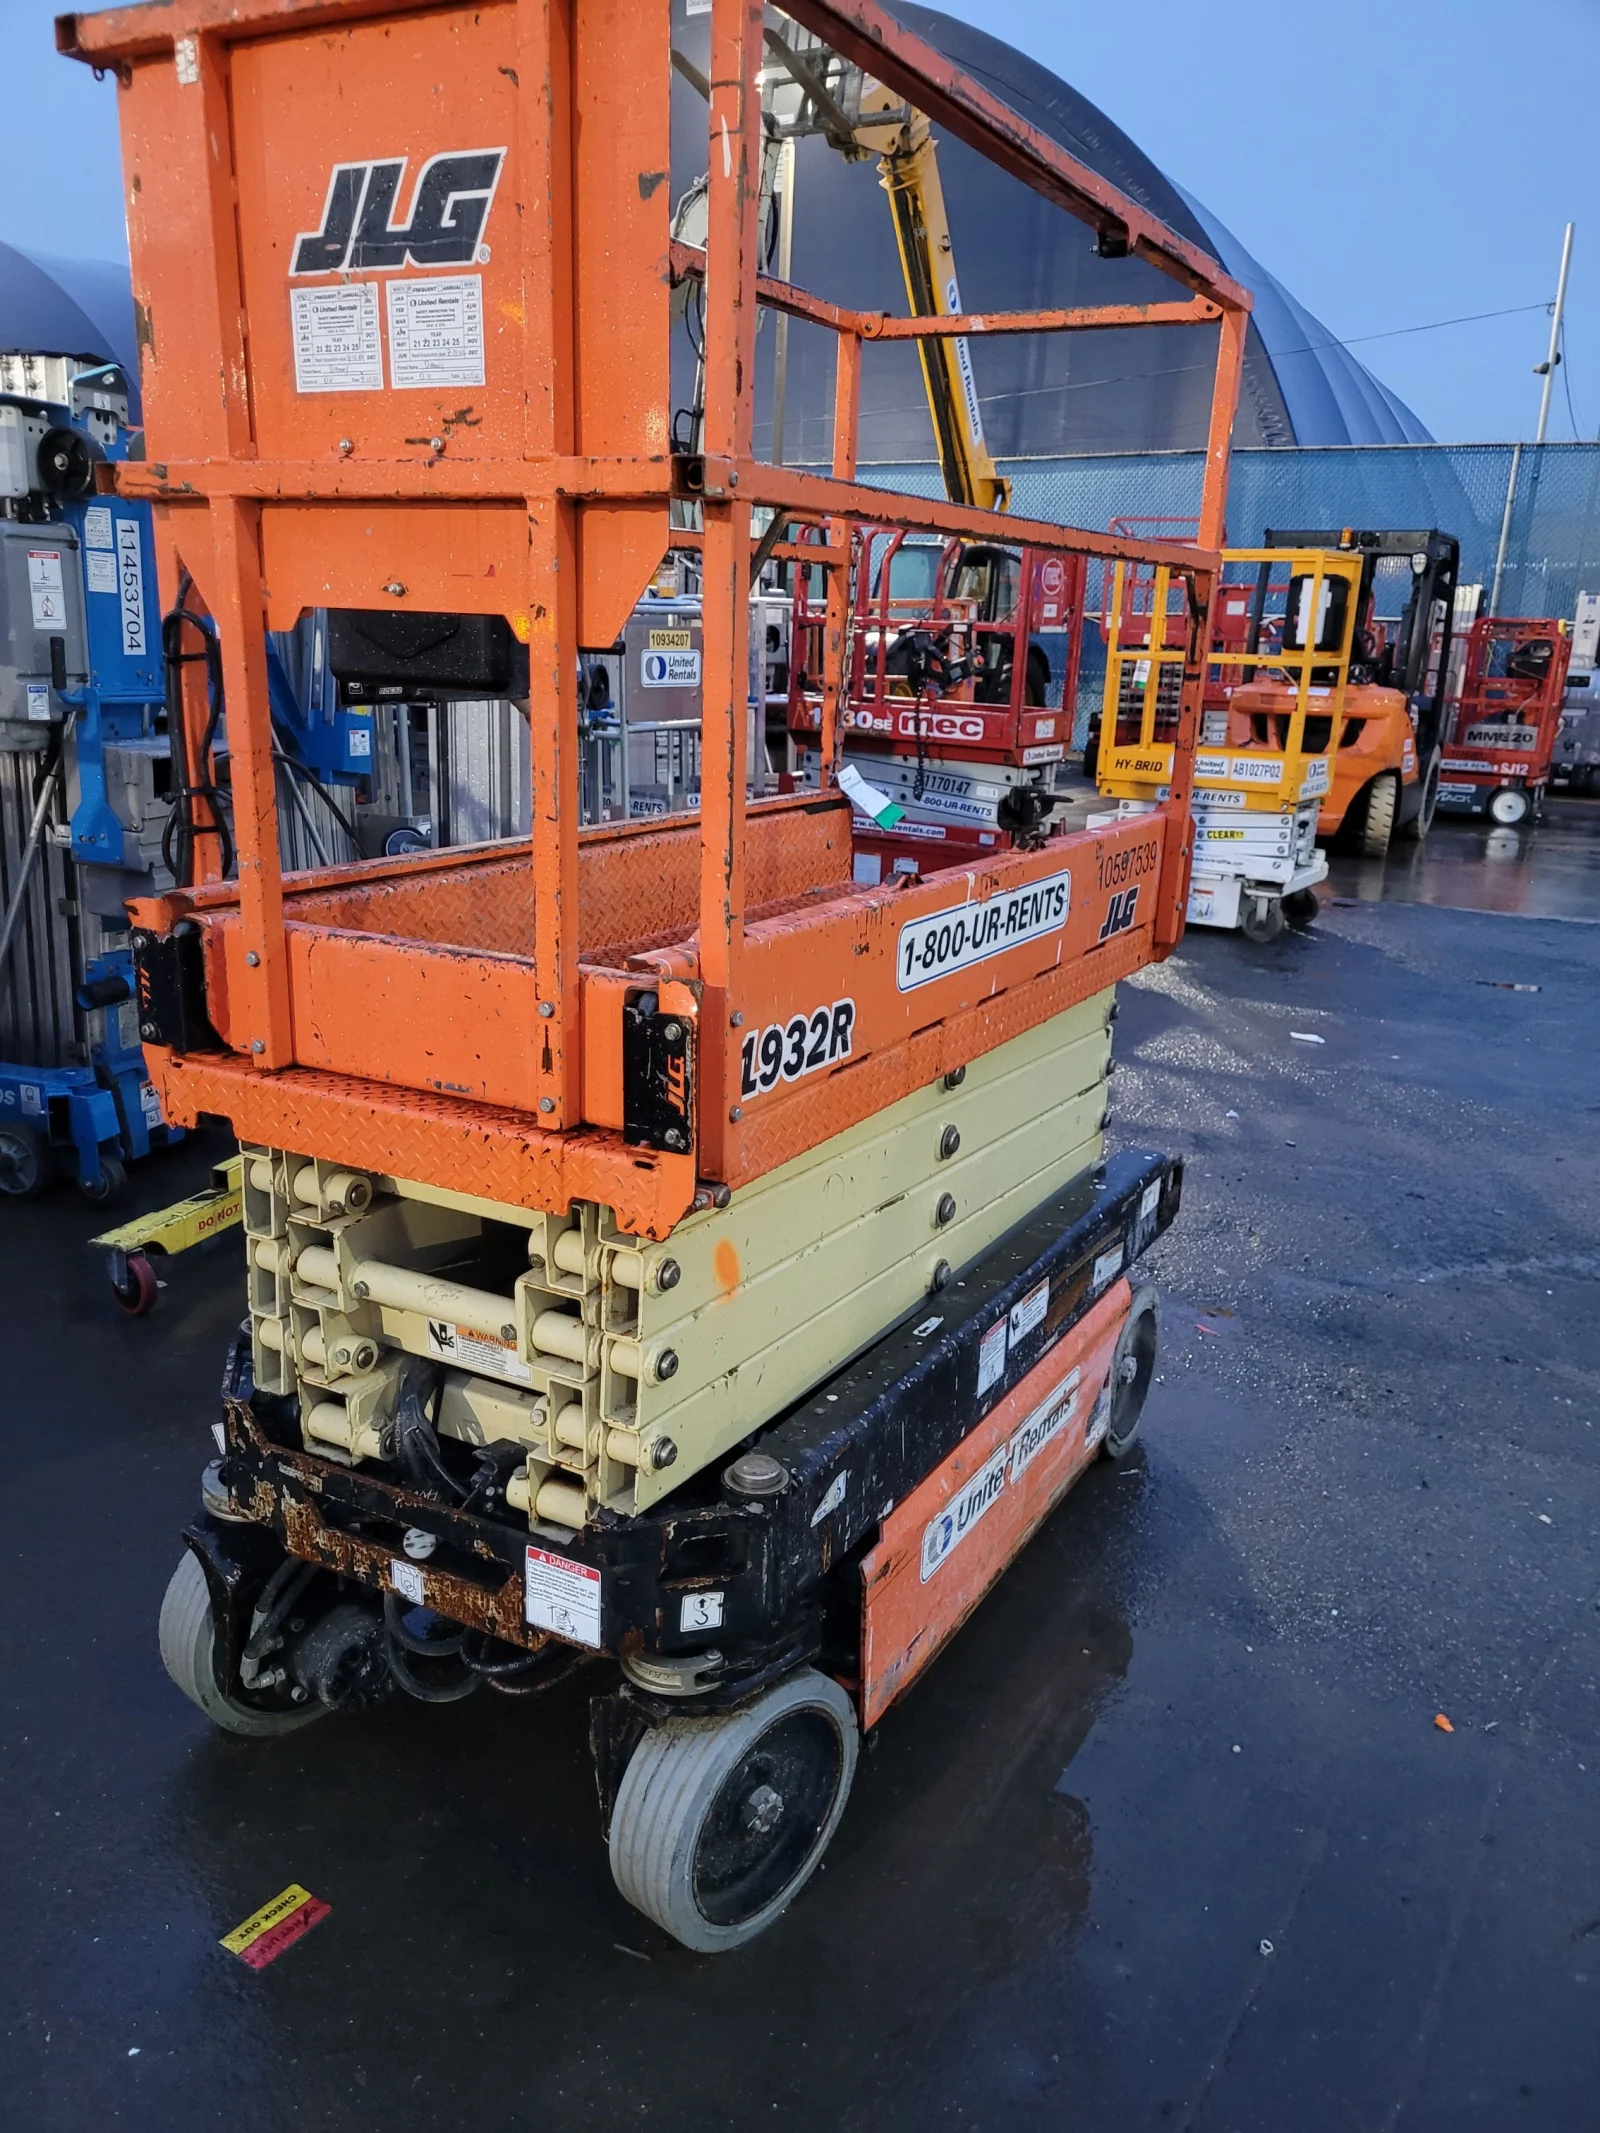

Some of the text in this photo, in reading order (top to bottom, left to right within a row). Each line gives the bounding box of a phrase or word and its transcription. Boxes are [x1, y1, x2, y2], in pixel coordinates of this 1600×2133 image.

[292, 149, 505, 274] JLG
[964, 374, 980, 437] Rentals
[120, 524, 142, 650] 11453704
[651, 633, 689, 646] 10934207
[668, 655, 695, 667] United
[668, 668, 697, 680] Rentals
[810, 707, 981, 738] 130SE mec
[1467, 731, 1534, 743] MME20
[1115, 758, 1163, 773] HY-BRID
[1194, 767, 1225, 776] Rentals
[1196, 759, 1281, 778] United AB1027P02
[1501, 762, 1529, 776] SJ12
[923, 796, 993, 817] 800-UR-RENTS
[1098, 840, 1158, 890] 10597539
[1100, 886, 1139, 939] JLG
[905, 882, 1066, 976] 1-800-UR-RENTS
[742, 1002, 853, 1097] 1932R
[667, 1054, 685, 1117] JLG
[198, 1203, 240, 1231] DO NOT
[475, 1331, 517, 1350] WARNING
[957, 1444, 1015, 1532] United
[529, 1560, 582, 1582] ELECTROCUTION HAZARD
[549, 1555, 588, 1578] DANGER
[238, 1894, 298, 1940] CHECK OUT
